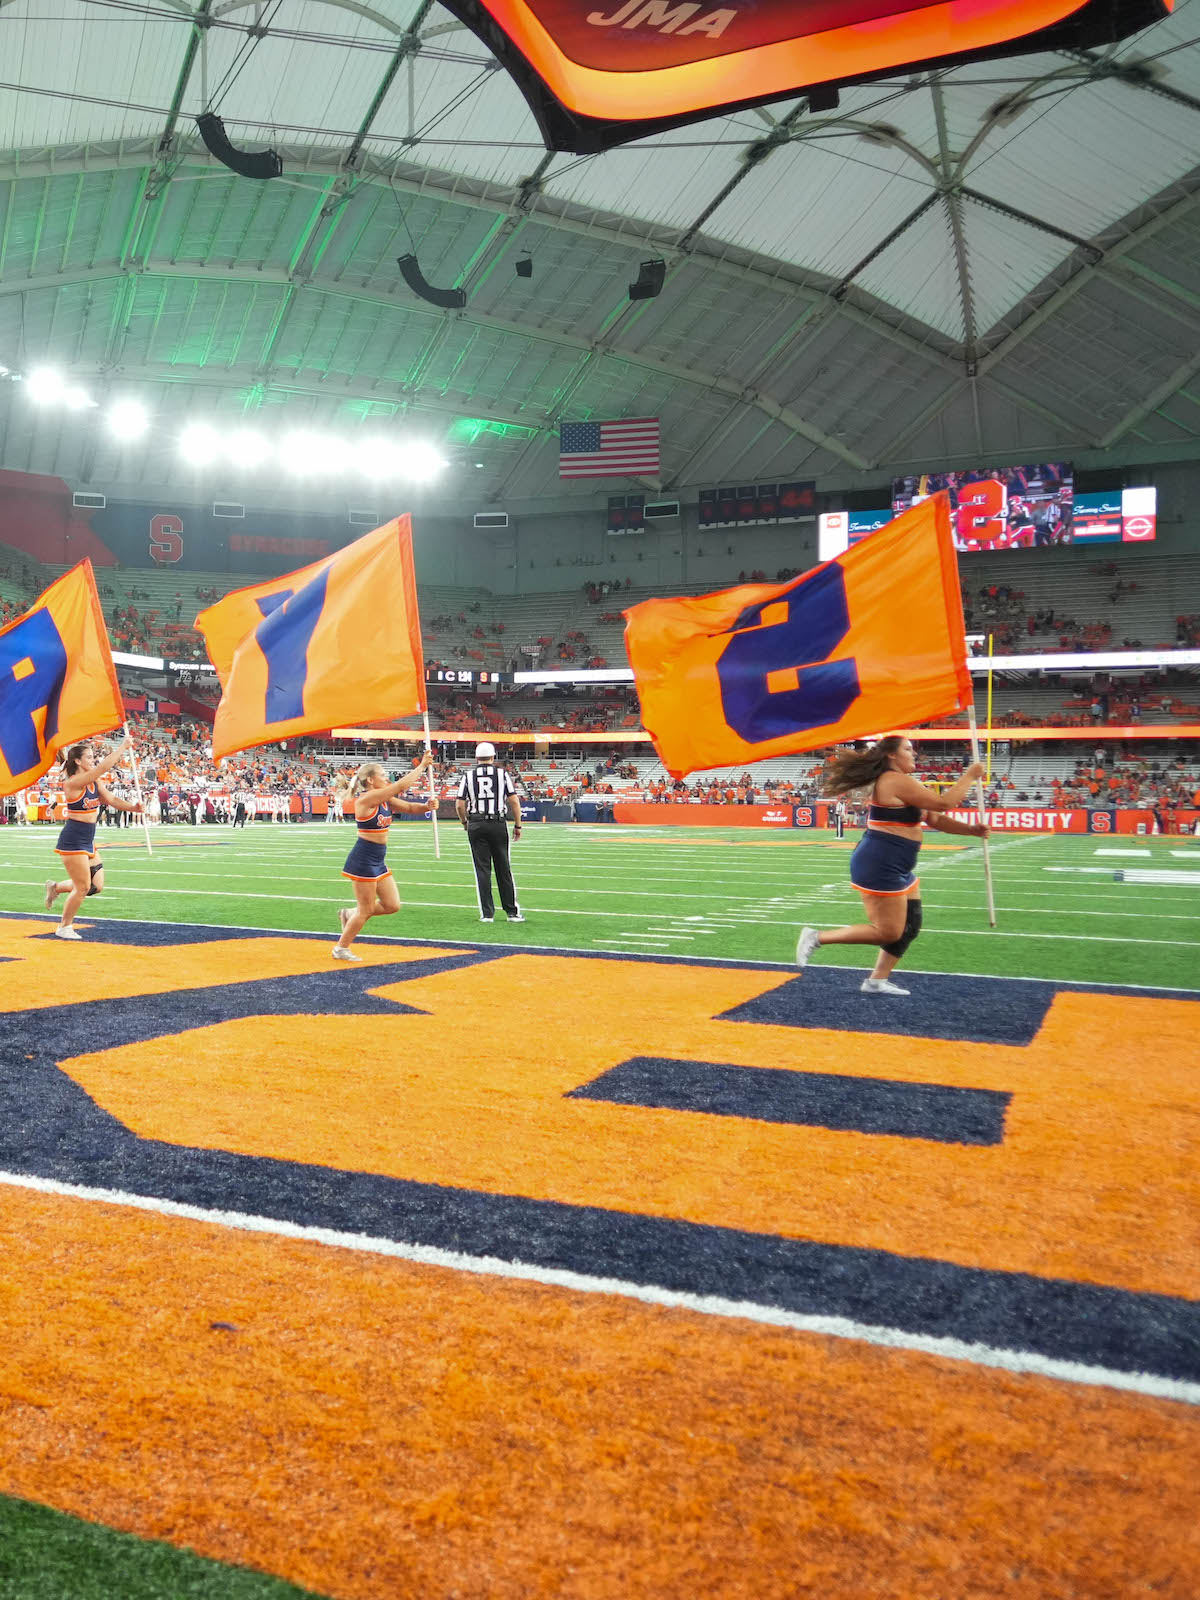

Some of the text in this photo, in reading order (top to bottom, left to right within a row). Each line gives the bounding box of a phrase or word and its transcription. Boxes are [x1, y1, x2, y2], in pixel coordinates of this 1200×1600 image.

[586, 0, 738, 39] JMA
[150, 513, 184, 563] S
[169, 661, 200, 671] Syracuse
[477, 776, 495, 799] R
[796, 807, 813, 827] S
[1091, 811, 1112, 833] S
